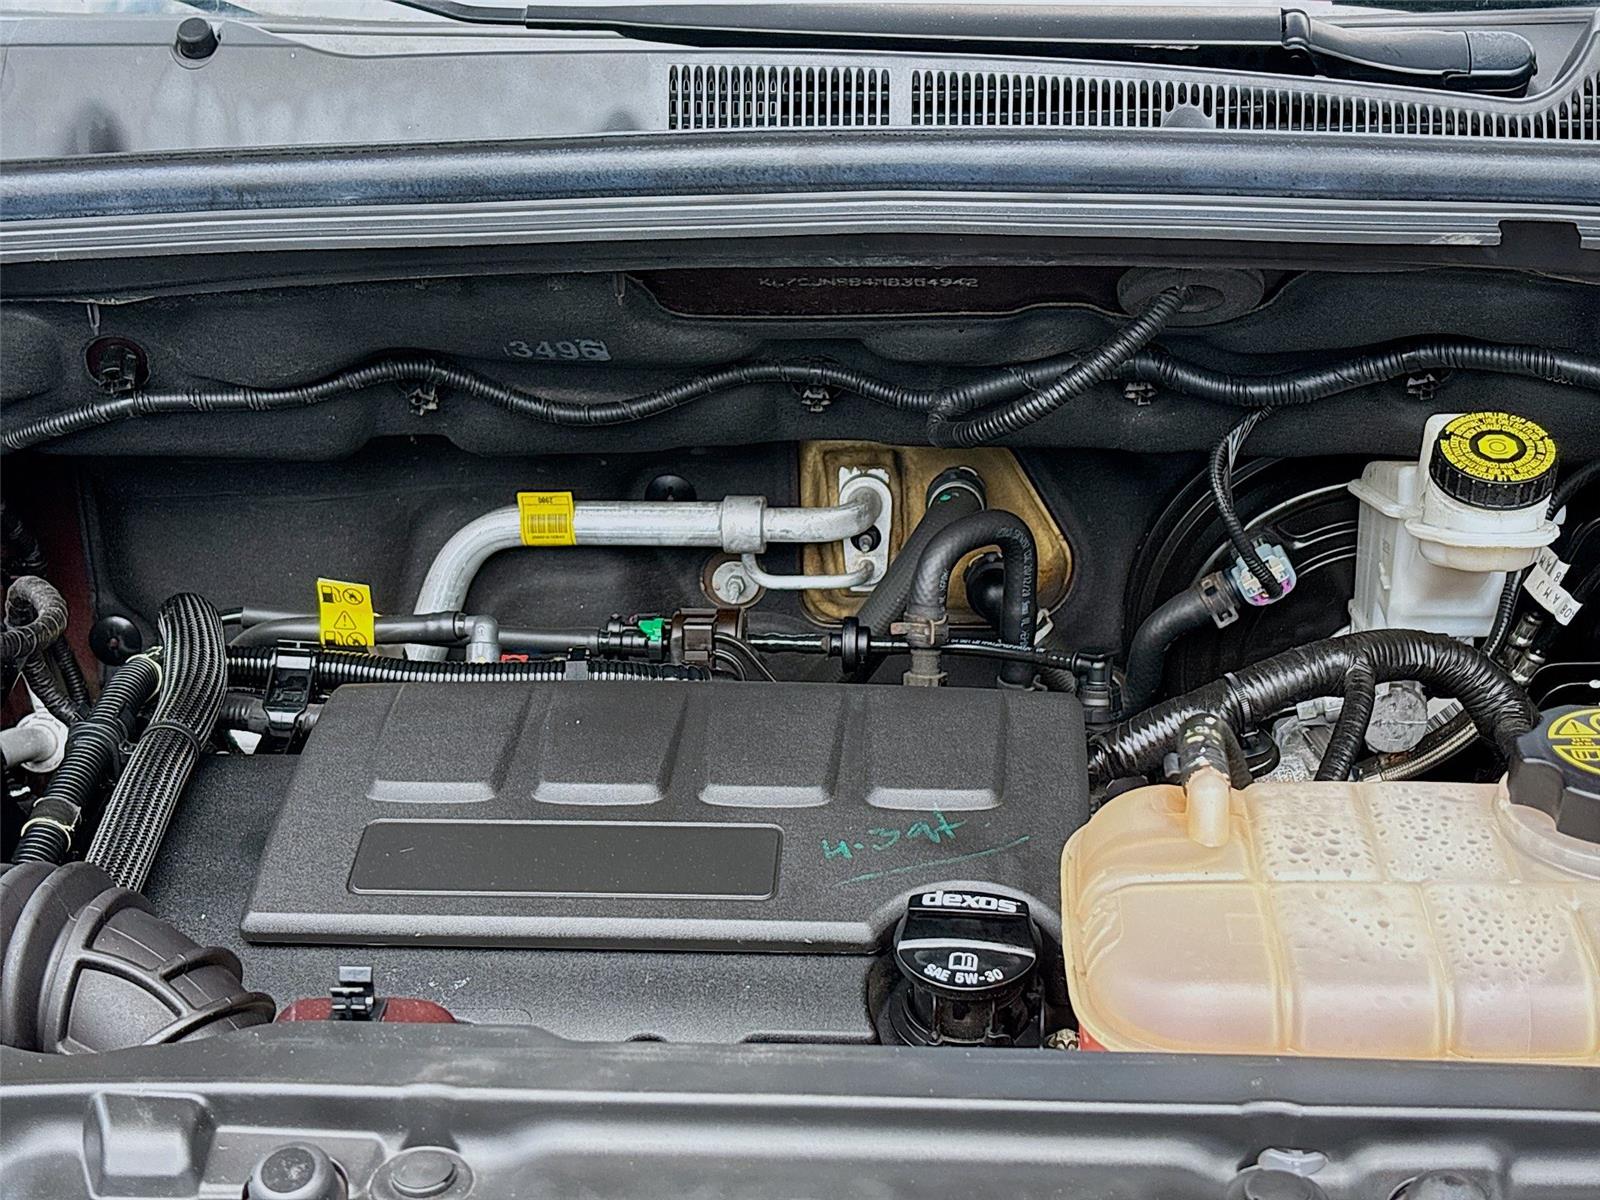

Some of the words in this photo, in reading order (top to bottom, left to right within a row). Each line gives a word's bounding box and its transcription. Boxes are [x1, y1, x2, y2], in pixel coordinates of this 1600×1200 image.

[921, 890, 1018, 913] dexos
[923, 963, 952, 982] SAE
[954, 968, 1005, 985] 5W-30
